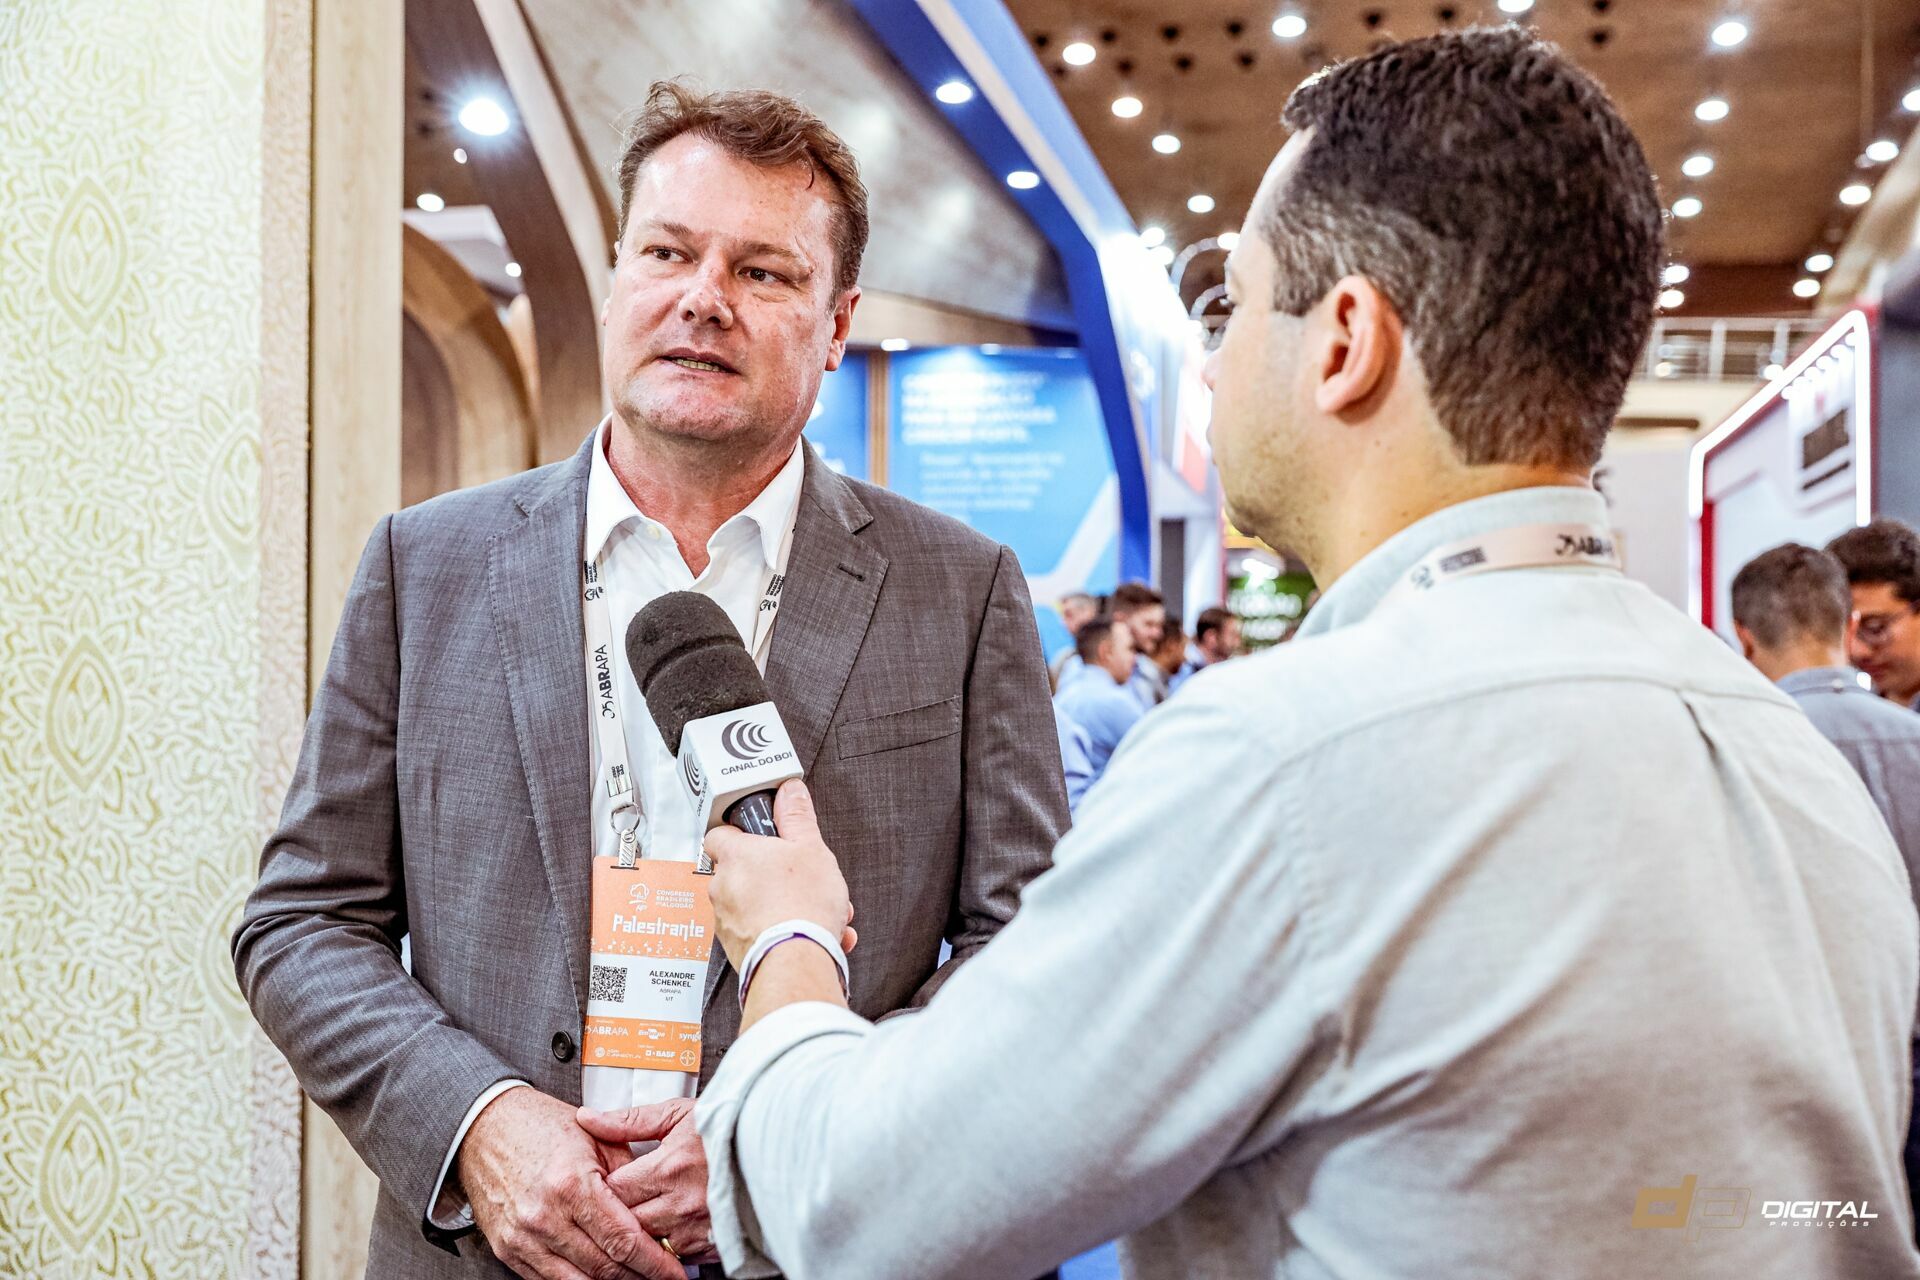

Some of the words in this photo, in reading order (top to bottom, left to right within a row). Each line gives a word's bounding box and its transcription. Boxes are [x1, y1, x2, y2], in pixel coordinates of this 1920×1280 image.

[594, 644, 613, 699] ABRAPA
[720, 761, 758, 775] CANAL
[758, 756, 774, 766] DO
[774, 751, 793, 762] BOI
[612, 912, 704, 942] Palestrante
[649, 970, 696, 981] ALEXANDRE
[651, 978, 692, 988] SCHENKEL
[592, 1026, 629, 1036] ABRAPA
